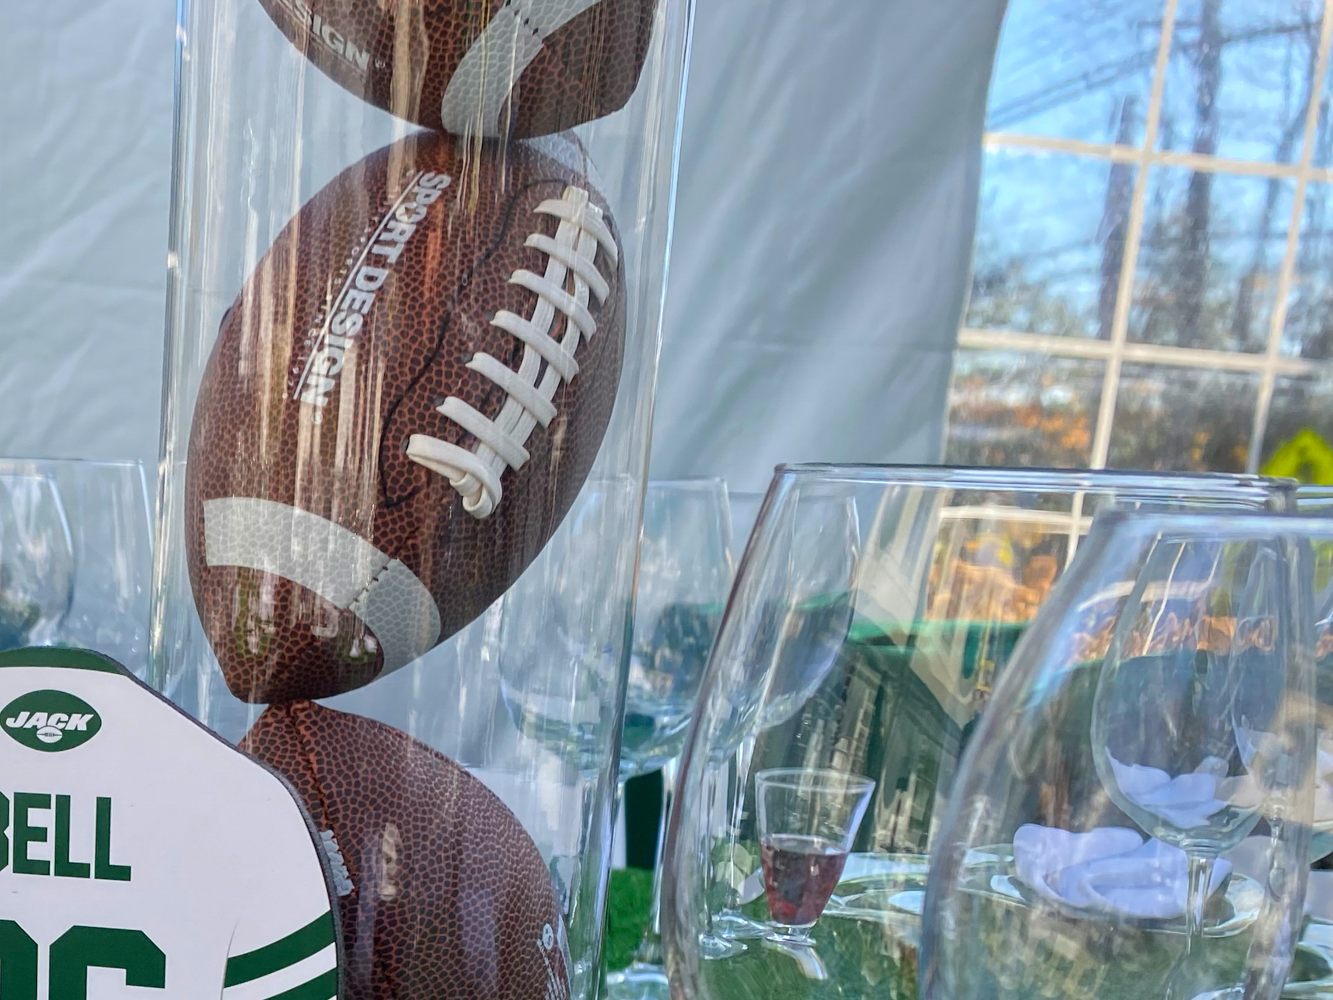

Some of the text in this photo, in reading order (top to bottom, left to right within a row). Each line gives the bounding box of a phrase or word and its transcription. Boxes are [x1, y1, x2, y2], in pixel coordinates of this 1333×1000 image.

[371, 172, 452, 264] SPORT
[300, 266, 388, 407] DESIGN
[5, 711, 95, 731] JACK
